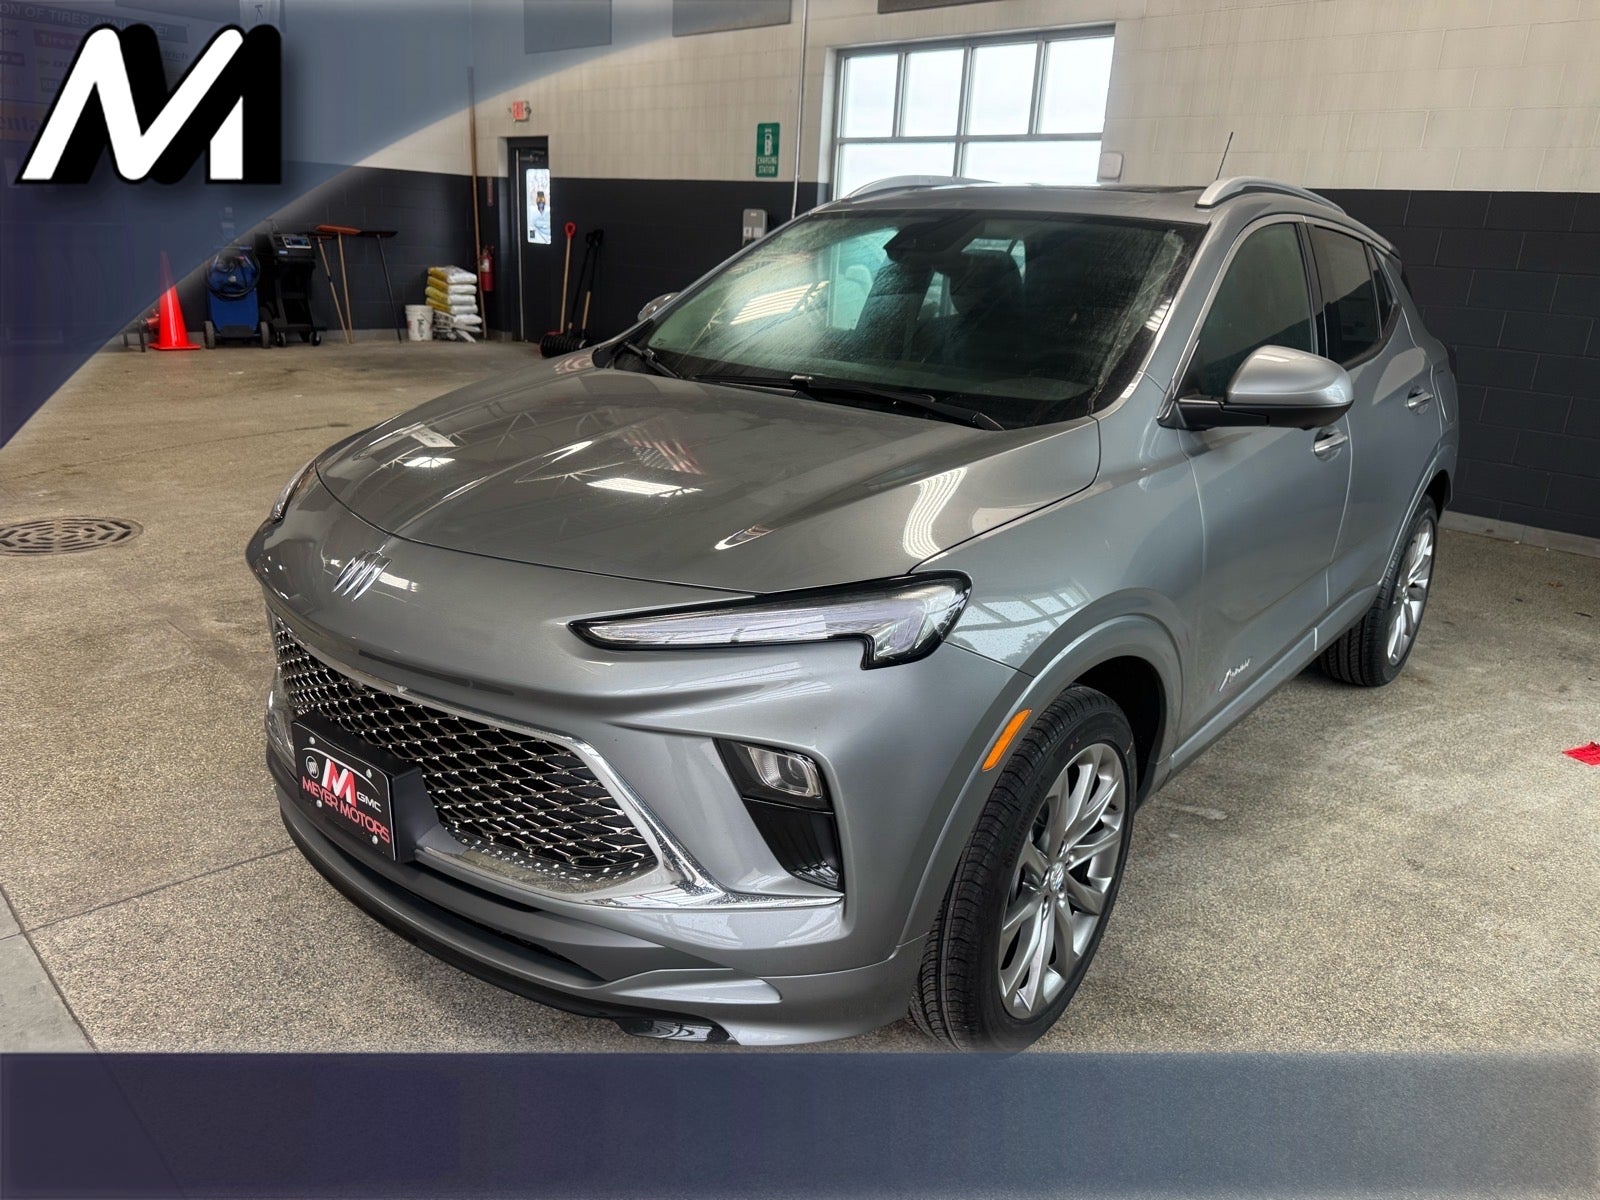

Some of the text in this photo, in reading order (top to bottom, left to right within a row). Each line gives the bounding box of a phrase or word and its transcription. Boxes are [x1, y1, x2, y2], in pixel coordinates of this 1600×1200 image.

[302, 776, 391, 844] MEYER MOTORS
[356, 791, 383, 813] GMC
